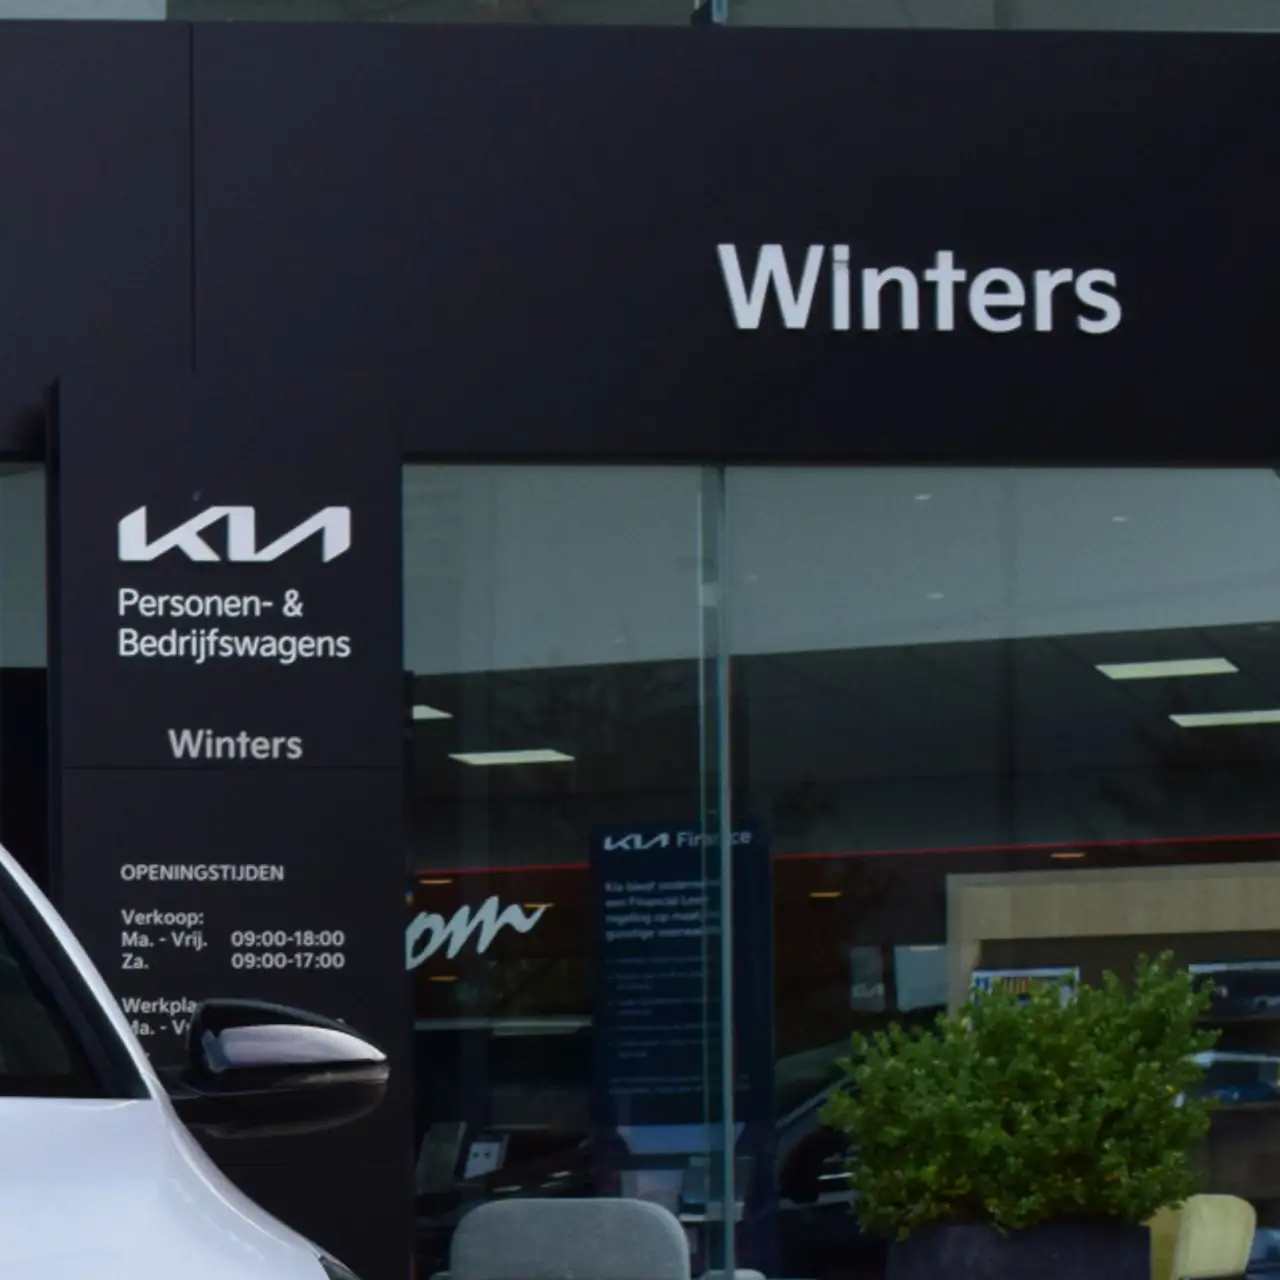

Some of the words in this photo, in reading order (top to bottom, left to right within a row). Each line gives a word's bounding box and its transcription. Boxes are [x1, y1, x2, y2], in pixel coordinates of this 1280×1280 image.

[717, 243, 1123, 334] Winters
[118, 505, 352, 563] KIA
[118, 587, 274, 618] Personen-
[282, 588, 304, 618] &
[118, 627, 352, 665] Bedrijfswagens
[168, 728, 304, 760] Winters
[603, 832, 670, 852] KIA
[119, 863, 285, 882] OPENINGSTIJDEN
[121, 909, 205, 929] Verkoop:
[121, 930, 155, 948] Ma.
[170, 930, 209, 952] Vrij.
[230, 930, 346, 948] 09:00-18:00
[121, 952, 150, 970] Za.
[230, 951, 346, 970] 09:00-17:00
[121, 997, 198, 1016] Werkpla
